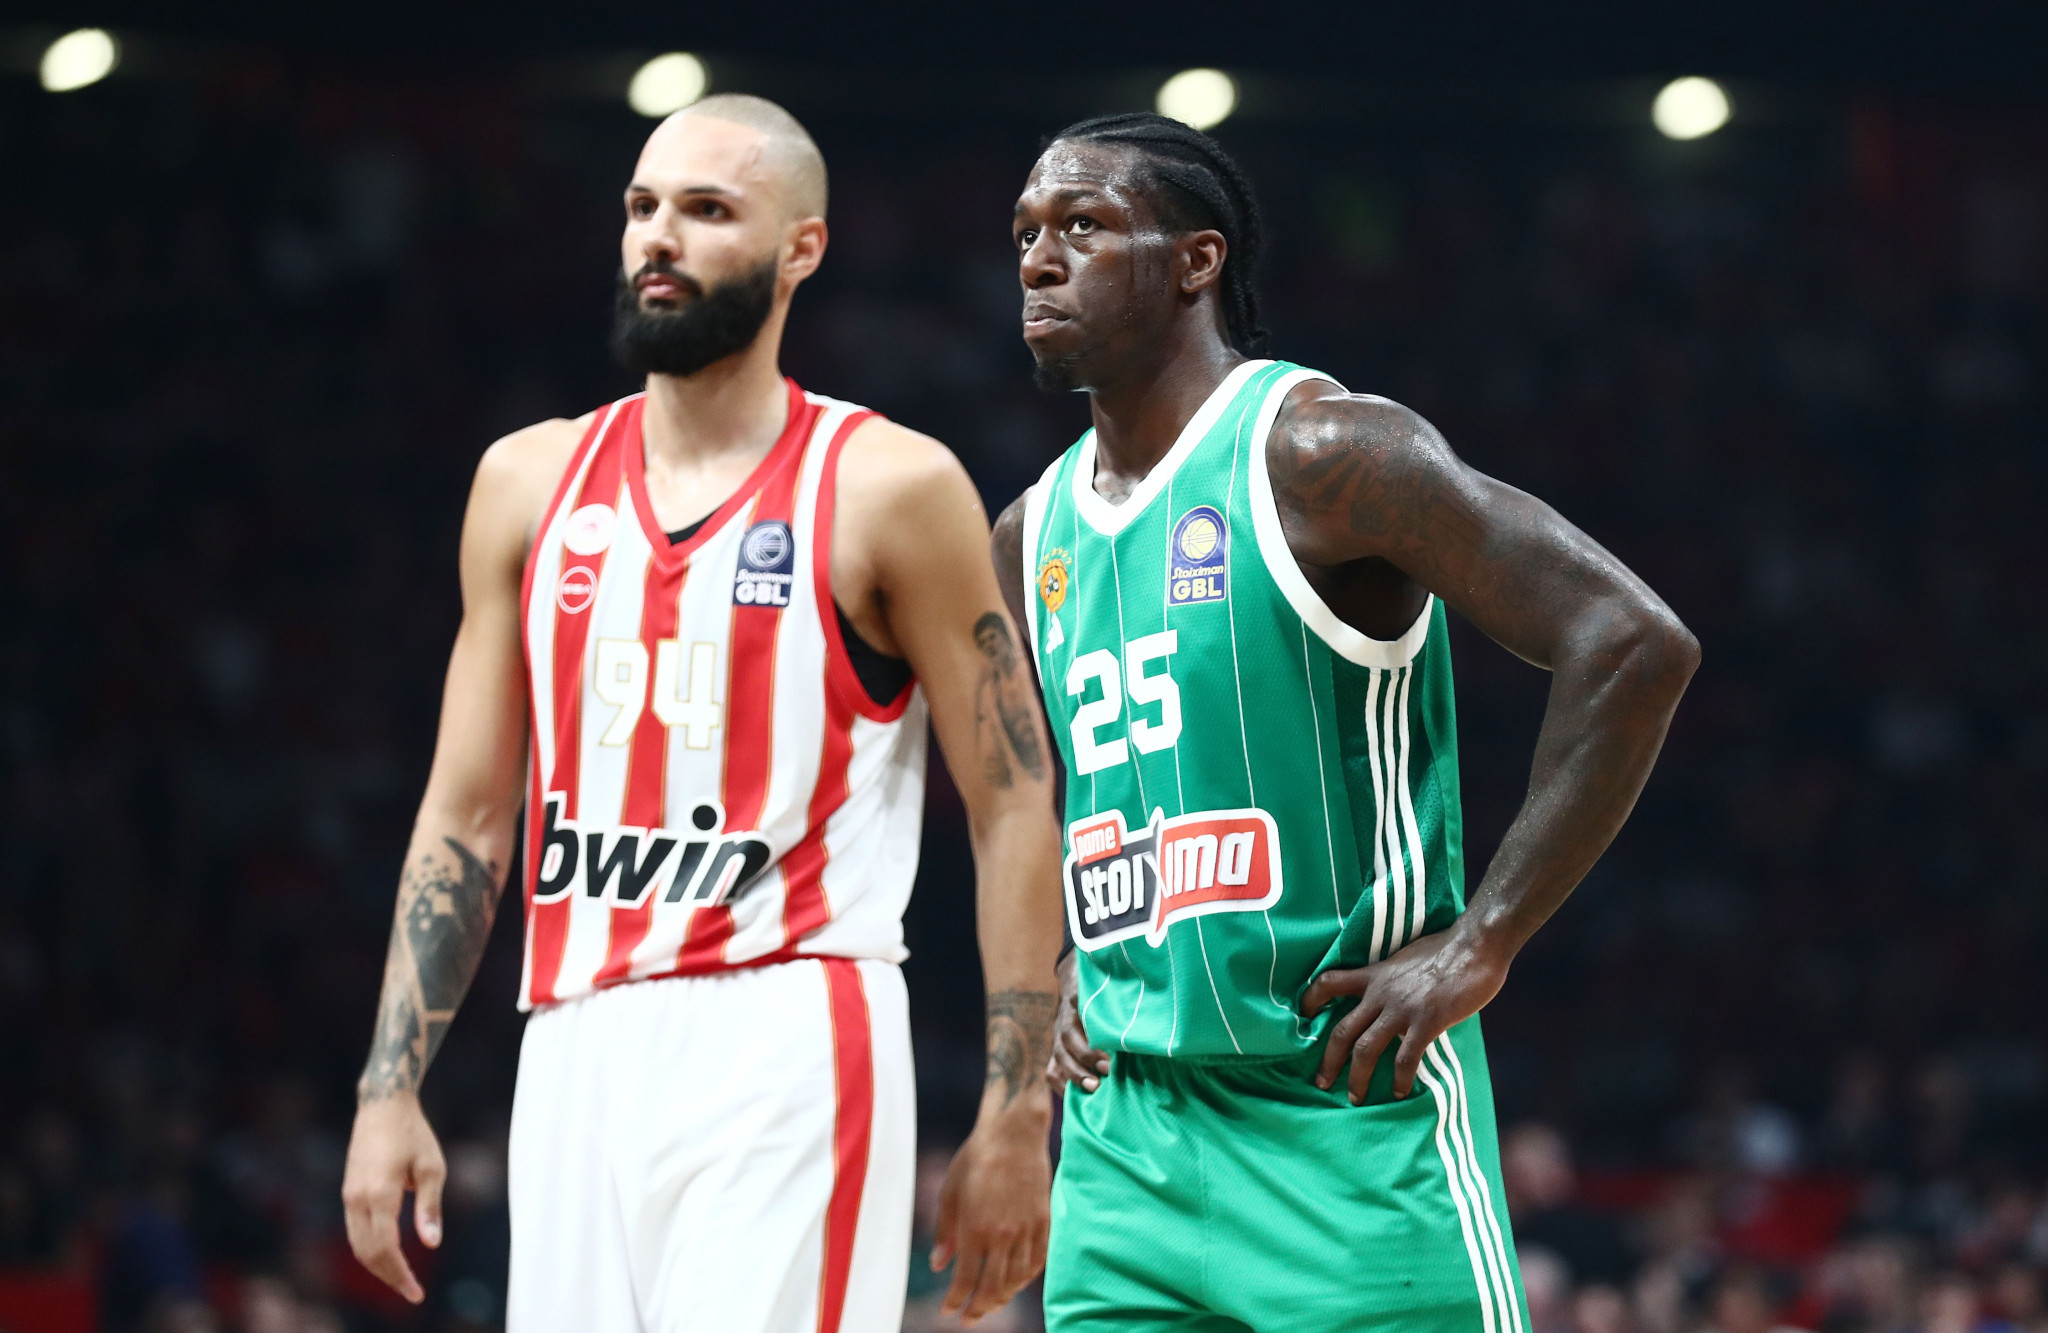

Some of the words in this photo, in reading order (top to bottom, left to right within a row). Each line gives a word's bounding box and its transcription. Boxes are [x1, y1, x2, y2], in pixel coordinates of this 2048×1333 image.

[1172, 565, 1224, 580] Stoiximan
[1173, 577, 1222, 600] GBL
[736, 582, 788, 605] GBL
[594, 637, 722, 750] 94
[1066, 629, 1183, 776] 25
[533, 796, 771, 904] bwin
[1075, 825, 1116, 863] pame
